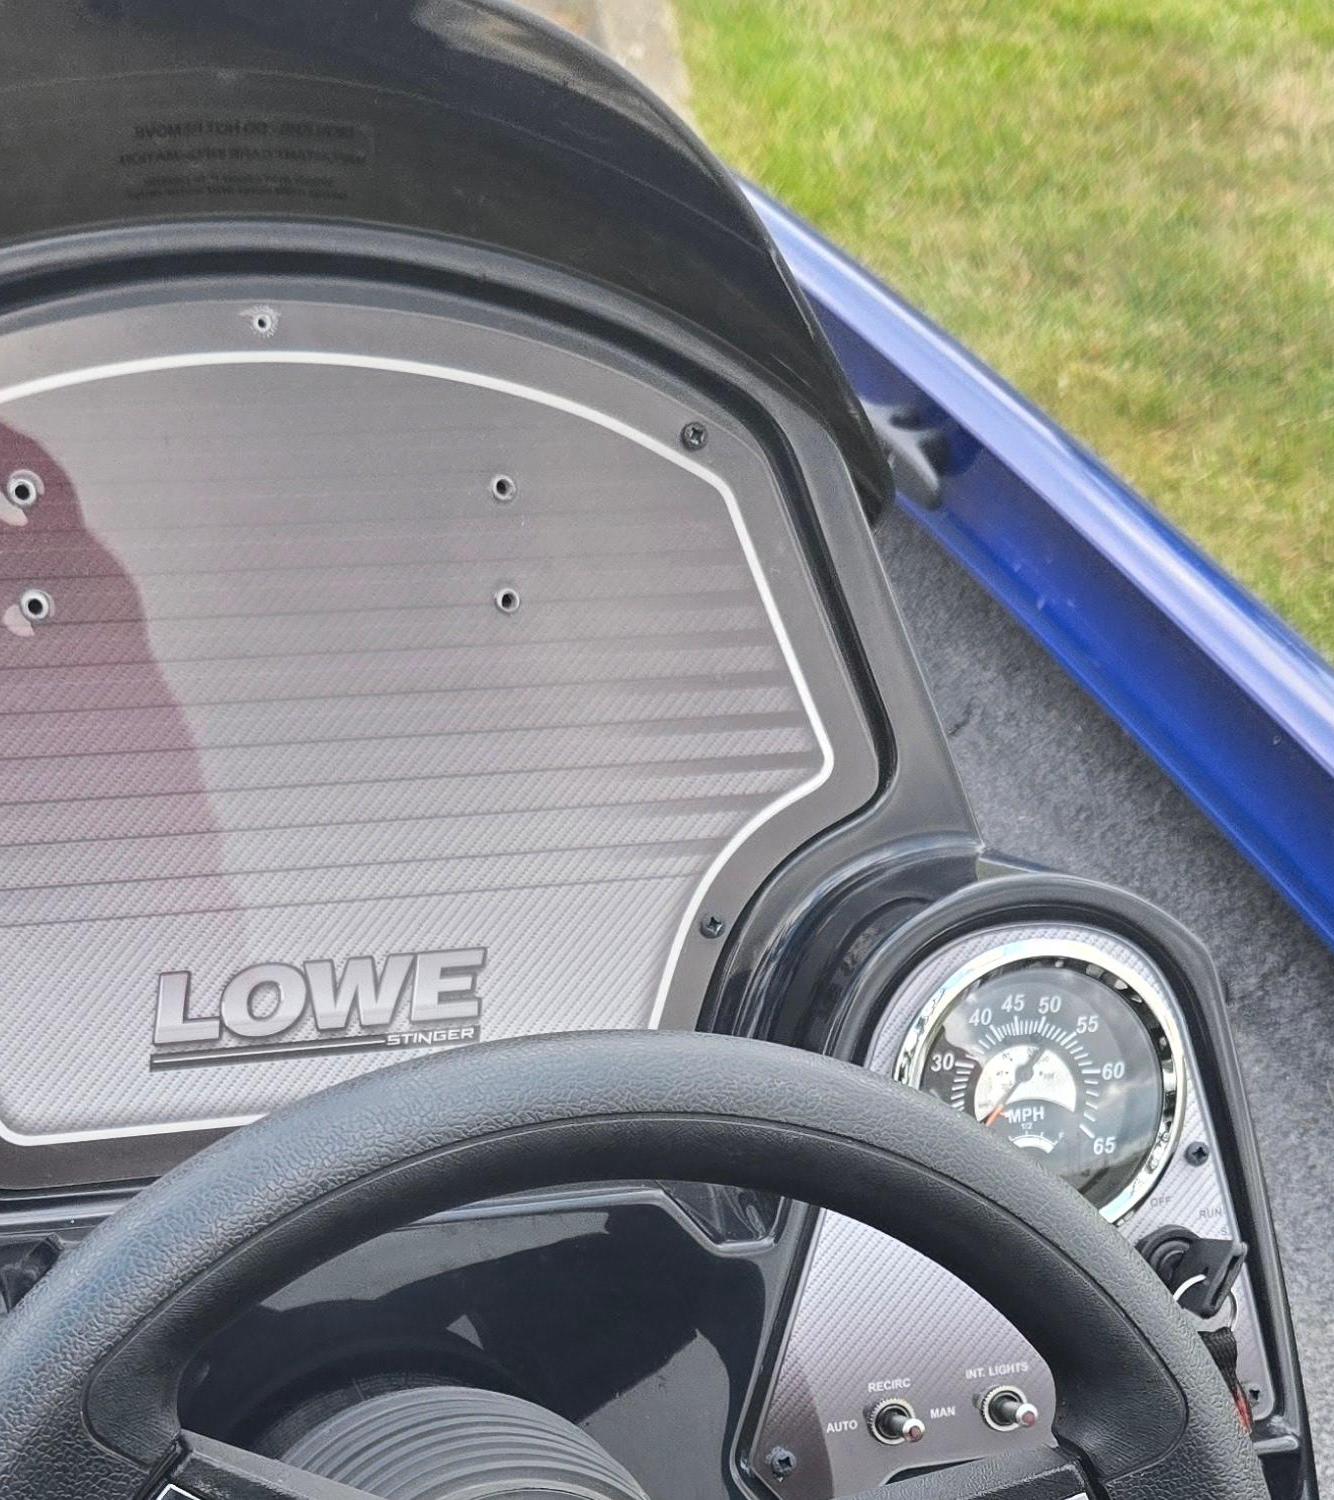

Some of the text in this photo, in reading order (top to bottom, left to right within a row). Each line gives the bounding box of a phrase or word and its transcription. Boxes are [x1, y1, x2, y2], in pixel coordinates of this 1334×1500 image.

[152, 946, 487, 1046] LOWE
[1001, 994, 1025, 1012] 45
[1038, 996, 1061, 1014] 50
[969, 1008, 992, 1026] 40
[1076, 1015, 1099, 1033] 55
[385, 1026, 476, 1047] STINGER
[930, 1053, 954, 1071] 30
[1102, 1061, 1125, 1080] 60
[1008, 1106, 1045, 1123] MPH
[1093, 1137, 1116, 1154] 65
[1150, 1195, 1171, 1207] OFF
[1199, 1207, 1222, 1219] RUN
[965, 1362, 1029, 1380] INT. LIGHTS
[868, 1378, 911, 1393] RECIRC
[930, 1406, 956, 1420] MAN
[826, 1419, 859, 1434] AUTO
